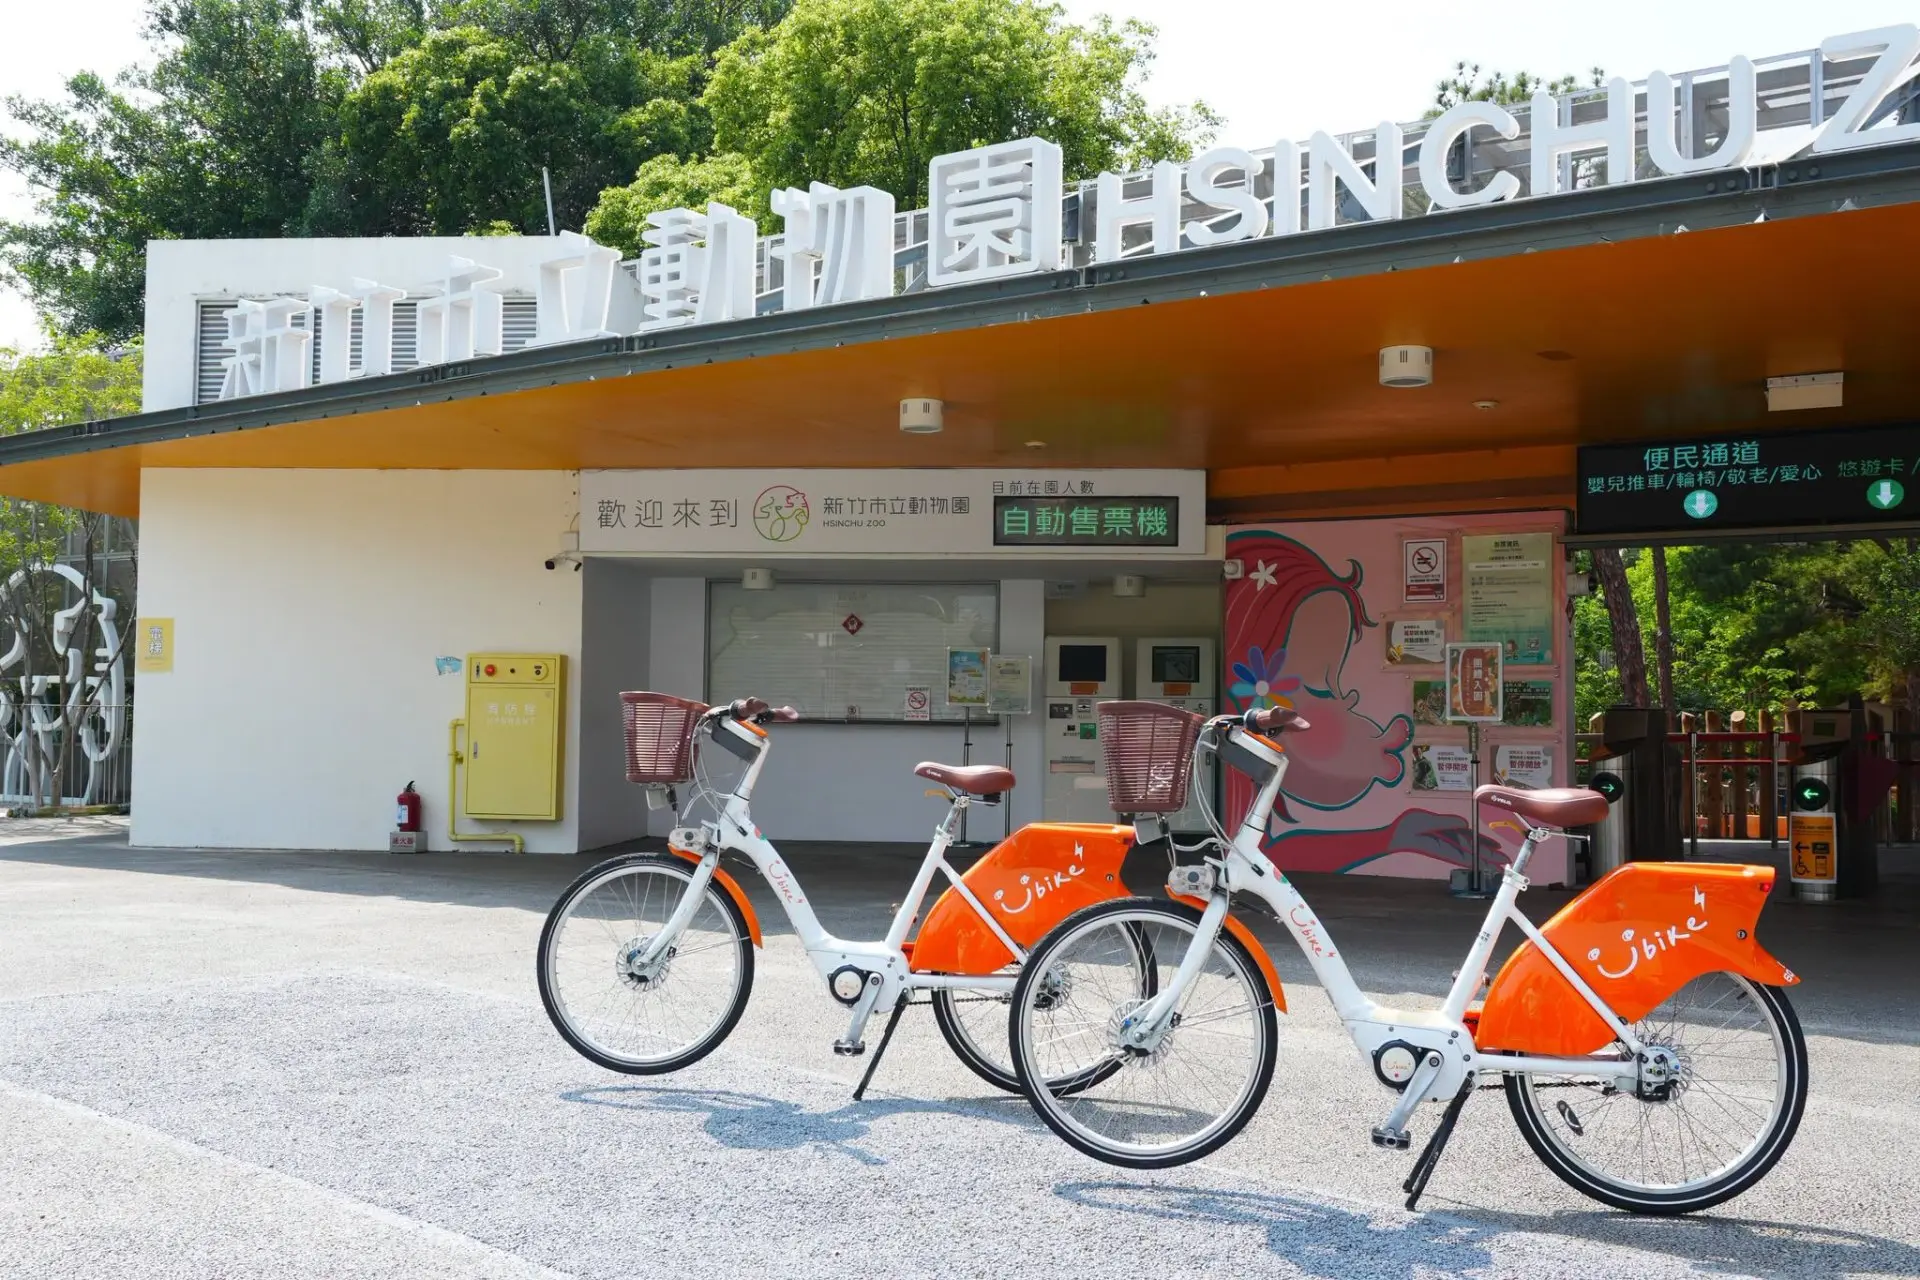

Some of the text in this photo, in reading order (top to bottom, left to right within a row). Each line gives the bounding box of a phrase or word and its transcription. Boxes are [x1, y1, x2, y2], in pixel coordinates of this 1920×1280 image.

[1095, 55, 1756, 263] HSINCHU
[219, 136, 1063, 399] 新竹市立動物園
[1643, 441, 1760, 471] 便民通道
[1838, 458, 1904, 477] 悠遊卡
[992, 480, 1095, 495] 目前在園人數
[1587, 463, 1822, 494] 嬰兒推車/輪椅/敬老/愛心
[597, 498, 738, 529] 歡迎來到
[823, 497, 970, 515] 新竹市立動物園
[823, 520, 886, 528] HSINCHU ZOO
[1003, 506, 1168, 537] 自動售票機
